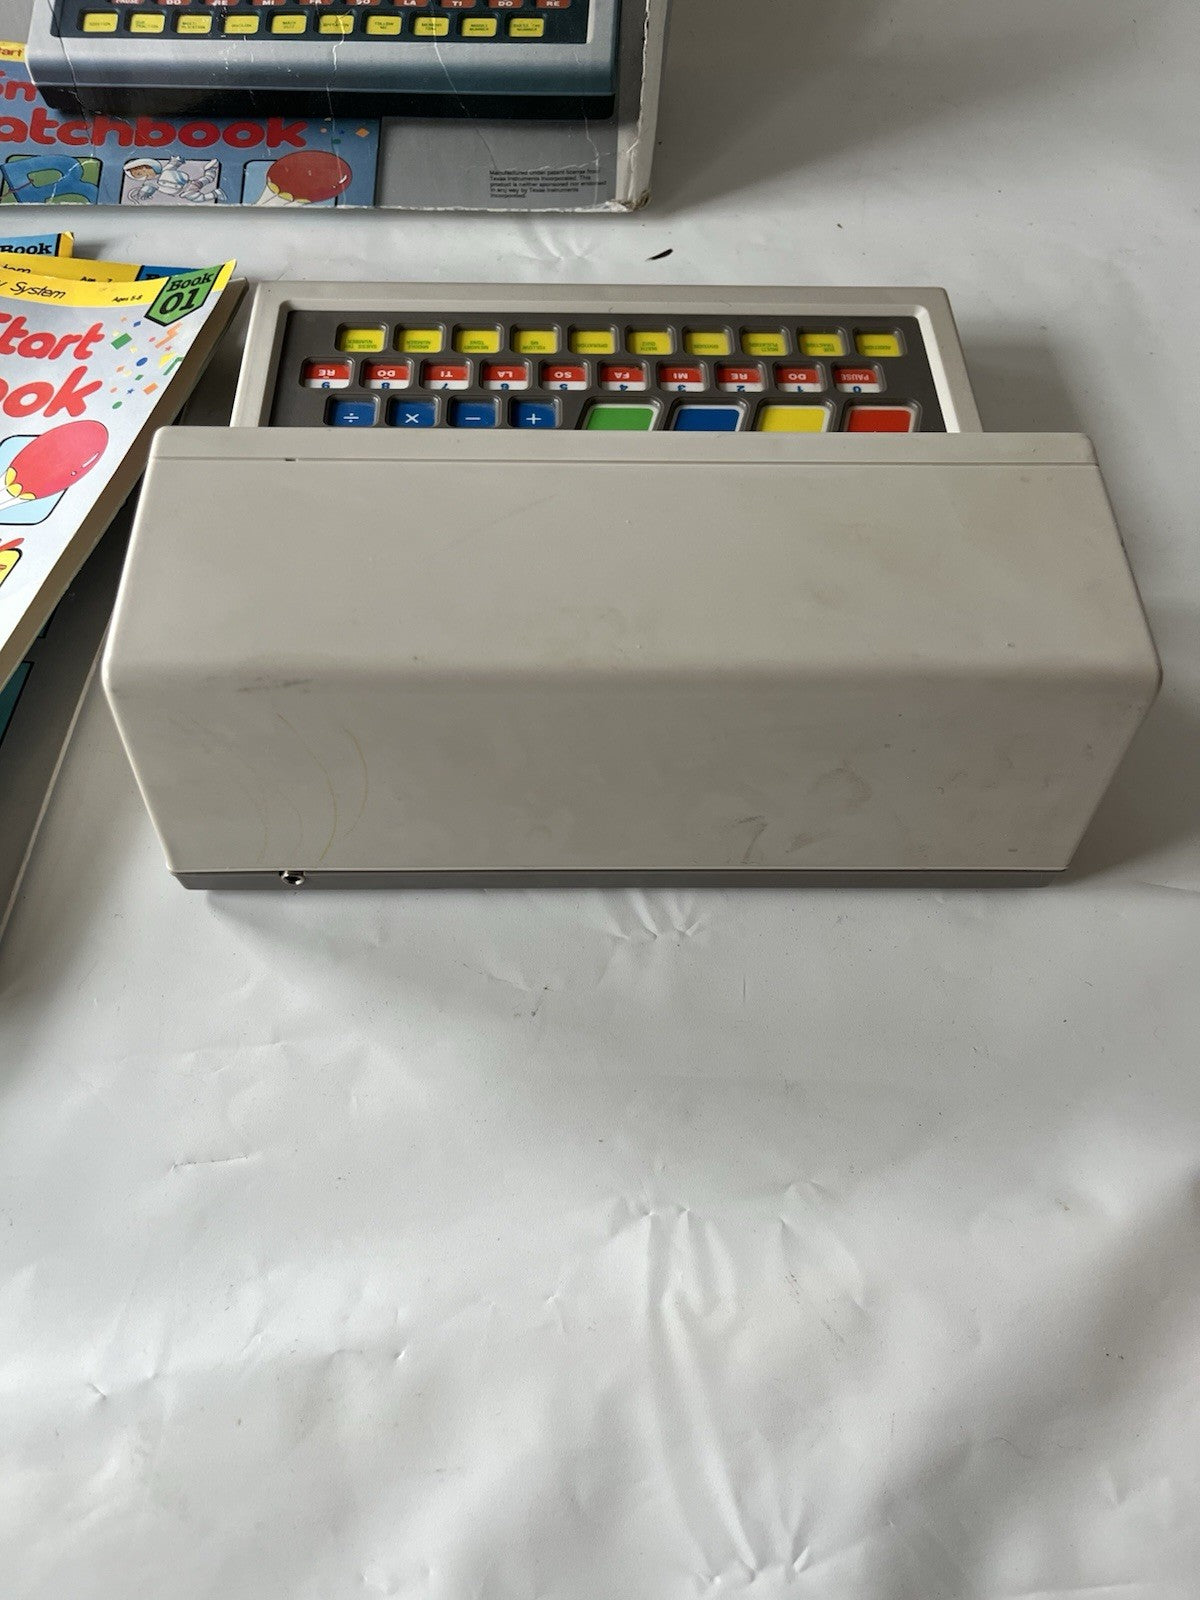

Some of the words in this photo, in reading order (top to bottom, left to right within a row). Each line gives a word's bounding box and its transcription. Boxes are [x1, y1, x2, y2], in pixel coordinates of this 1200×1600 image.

[10, 282, 66, 298] System
[166, 272, 214, 292] Book
[159, 288, 200, 314] 01
[0, 313, 105, 360] tart
[377, 369, 396, 377] DO
[0, 366, 103, 418] ok
